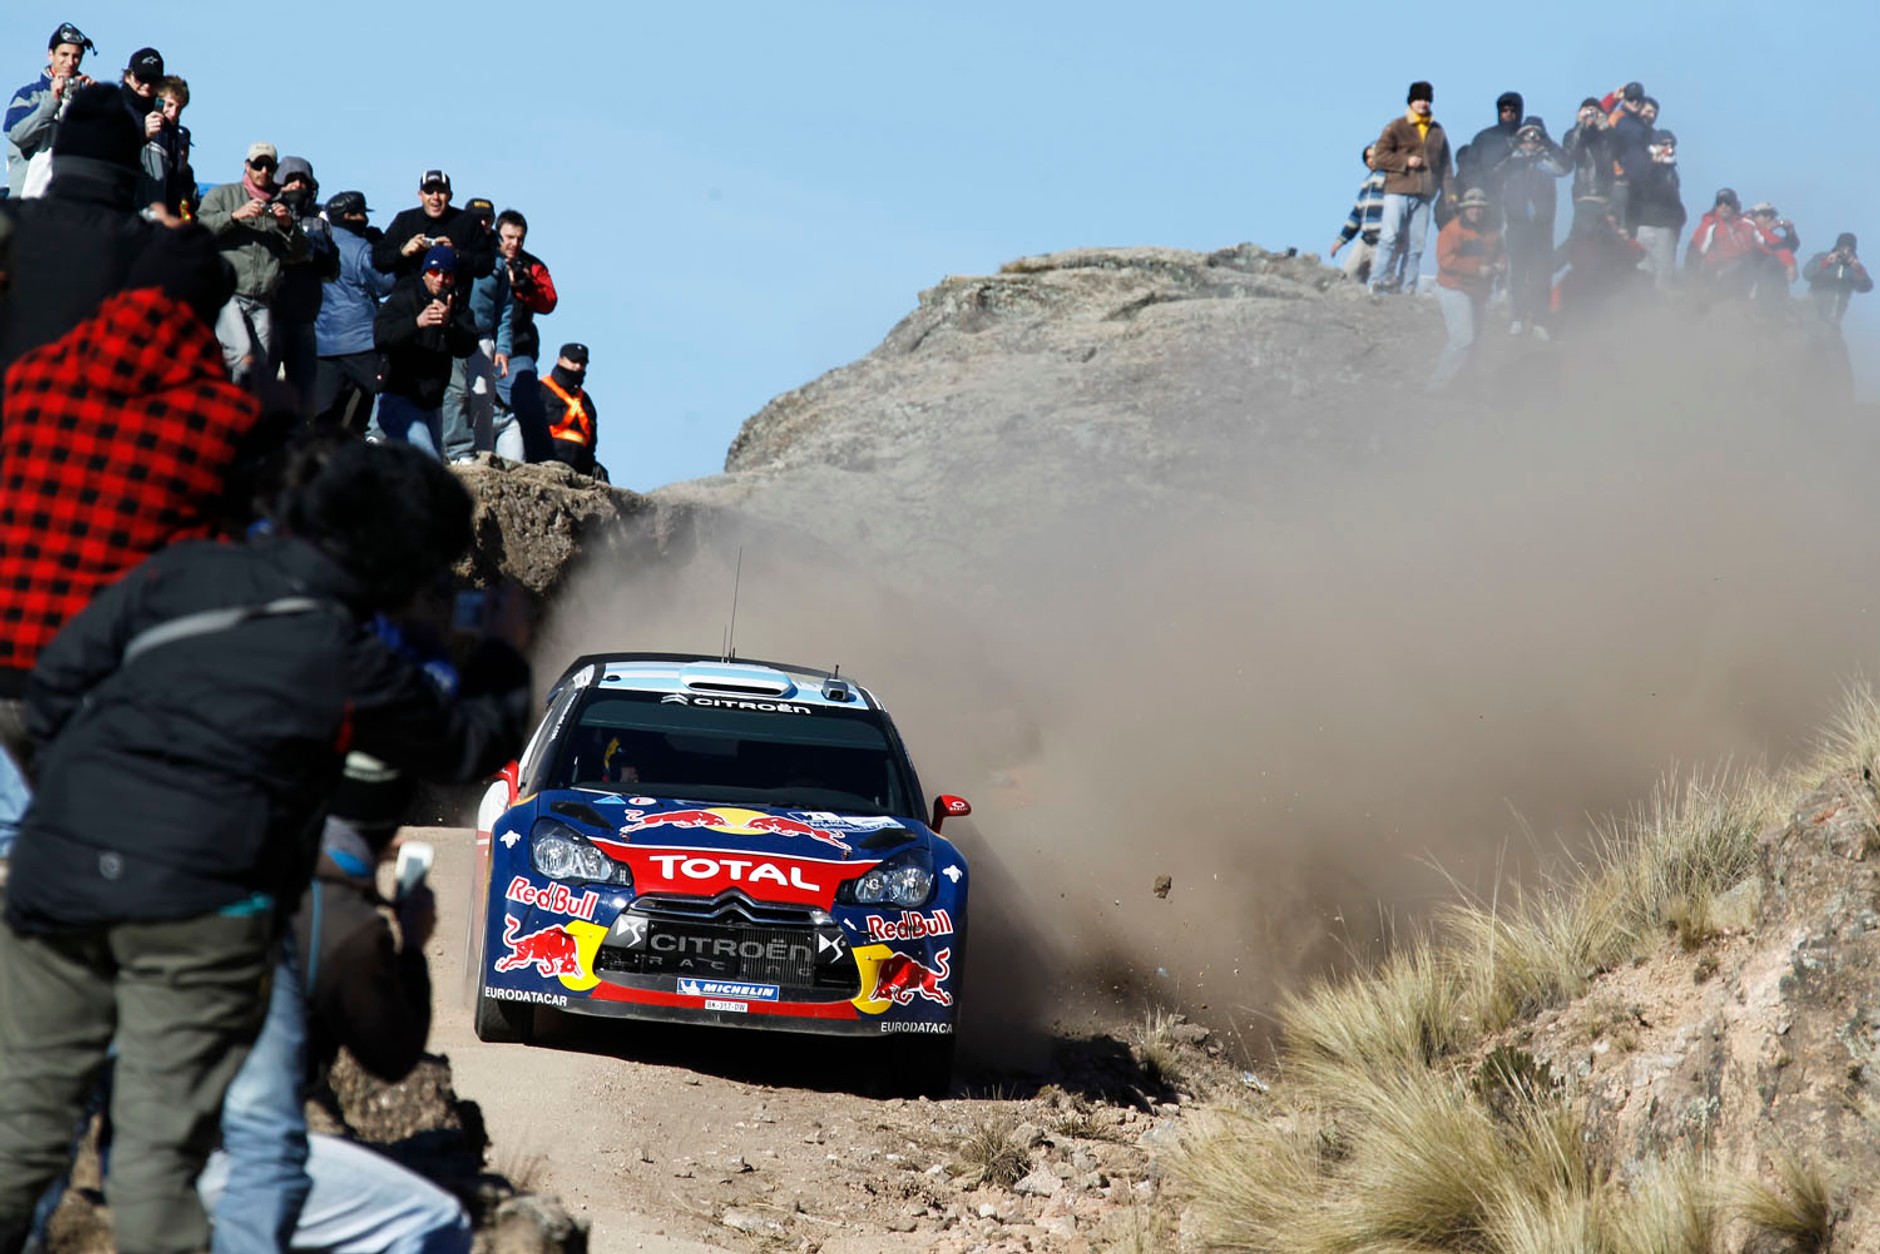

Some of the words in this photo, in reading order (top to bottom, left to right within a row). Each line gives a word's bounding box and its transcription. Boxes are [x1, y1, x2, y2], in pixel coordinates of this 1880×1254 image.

[649, 854, 820, 892] TOTAL
[485, 986, 568, 1007] EURODATACAR
[703, 983, 775, 997] MICHELIN
[706, 1001, 746, 1011] BK-317-DW
